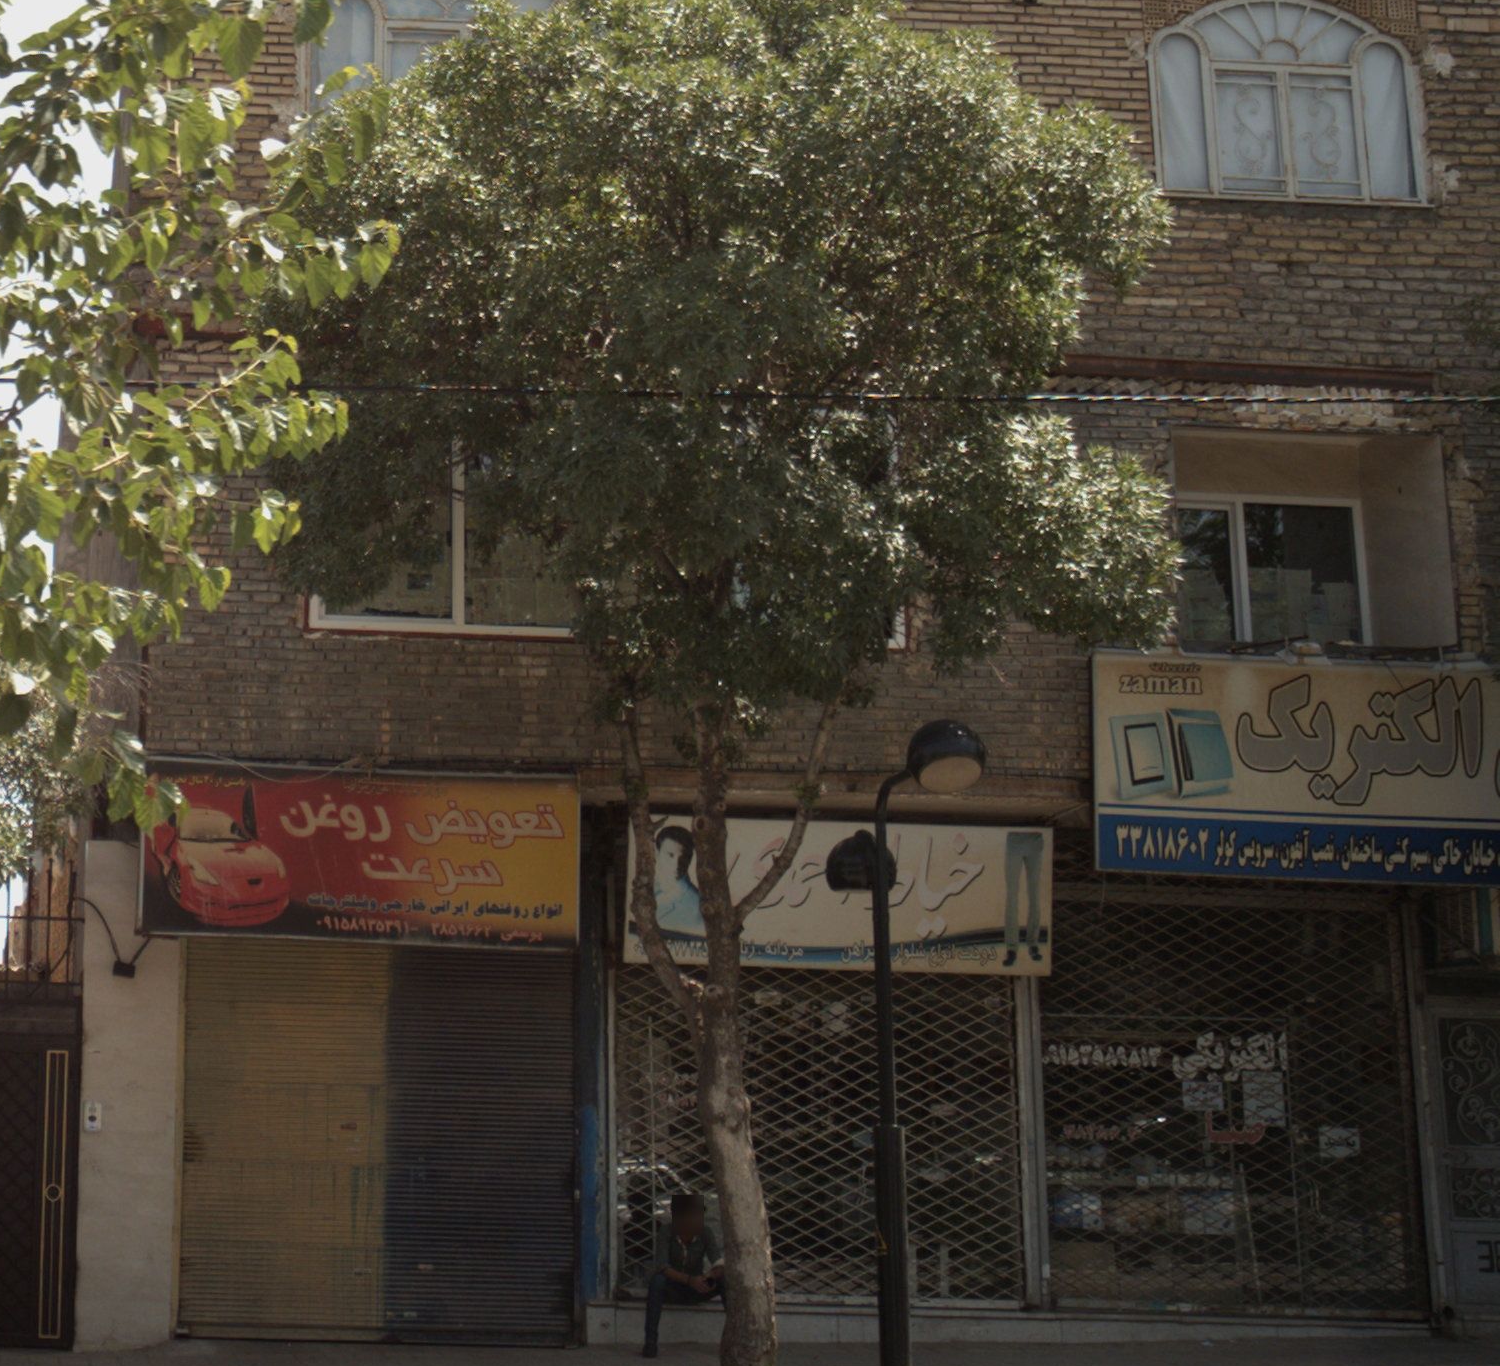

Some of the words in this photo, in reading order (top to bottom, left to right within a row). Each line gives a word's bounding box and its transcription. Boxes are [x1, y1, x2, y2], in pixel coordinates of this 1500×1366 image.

[1119, 674, 1203, 696] zaman
[1235, 673, 1483, 807] الکتریک
[279, 793, 392, 843] روغن
[405, 798, 566, 850] تعویض
[1116, 822, 1210, 862] ۳۳۸۱۸۶۰۲
[360, 852, 505, 895] سرعت
